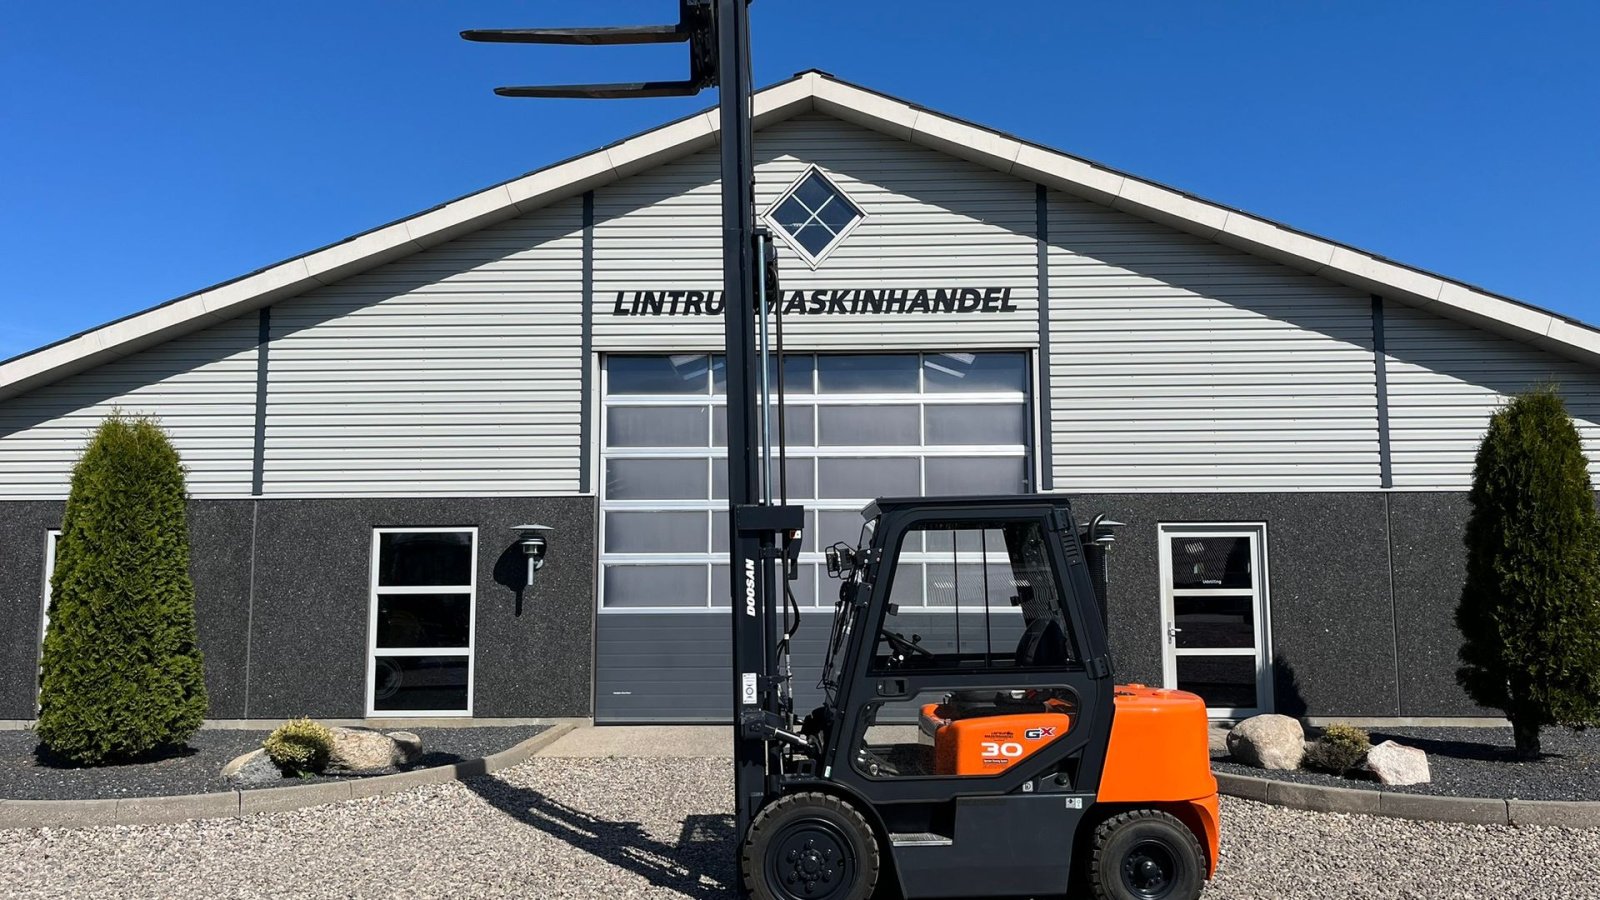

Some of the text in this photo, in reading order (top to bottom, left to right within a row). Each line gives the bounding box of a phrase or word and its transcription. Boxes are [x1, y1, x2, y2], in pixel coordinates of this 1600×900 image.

[613, 290, 726, 316] LINTRU
[745, 558, 756, 616] DOOSAN
[1025, 727, 1056, 740] GX
[981, 742, 1023, 757] 30
